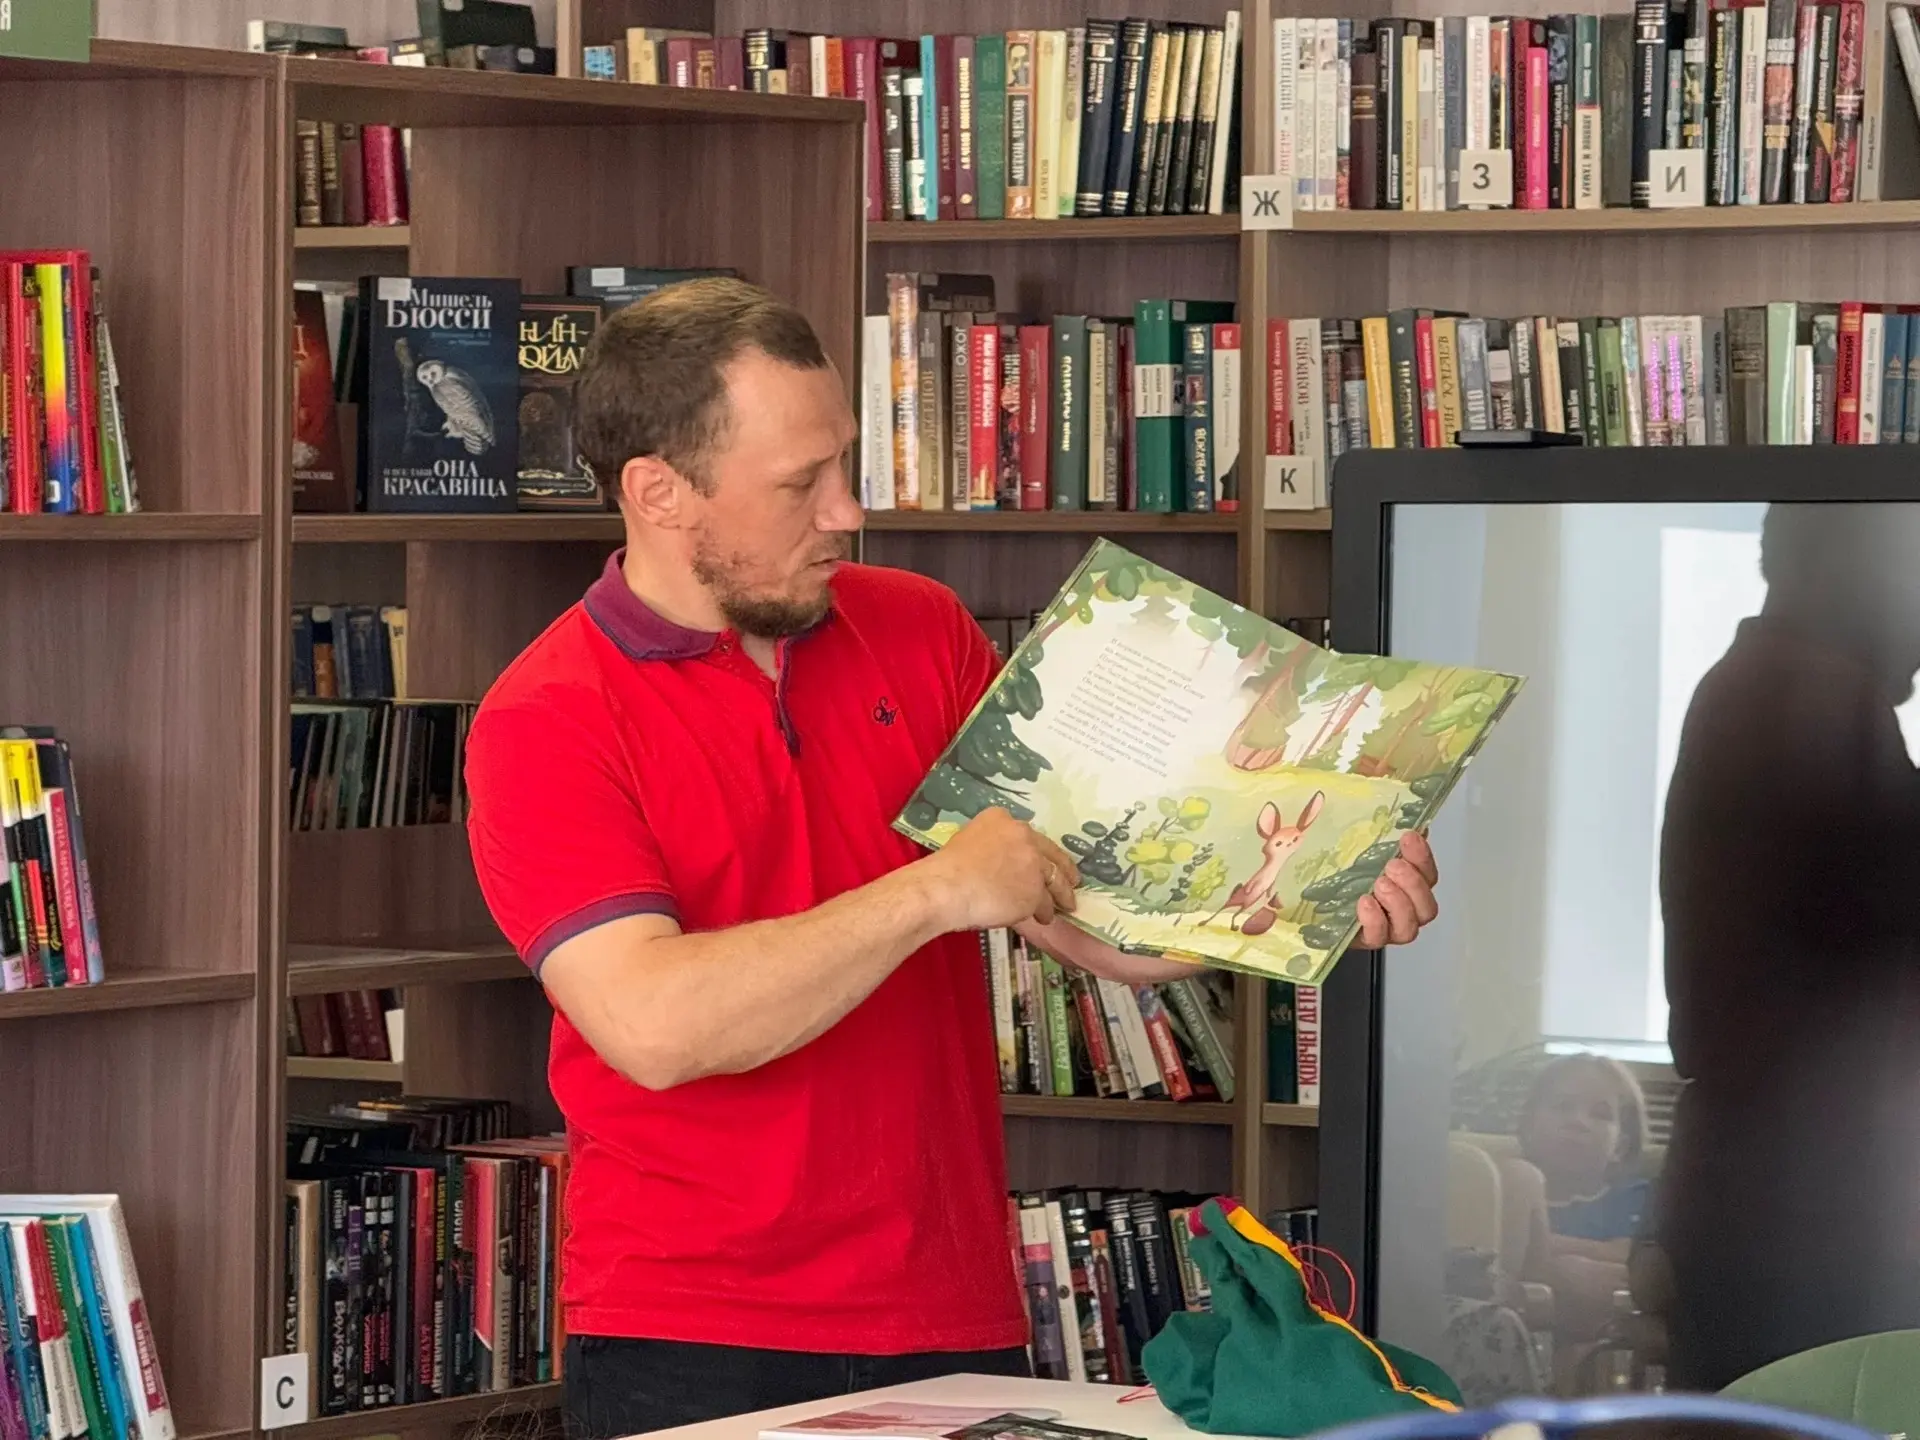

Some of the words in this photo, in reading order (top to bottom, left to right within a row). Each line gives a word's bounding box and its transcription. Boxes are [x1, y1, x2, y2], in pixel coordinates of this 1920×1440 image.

[1011, 99, 1025, 138] ЧЕХОВ
[1582, 115, 1592, 150] АПОЛЛОН
[1012, 143, 1026, 181] АНТОН
[1473, 163, 1490, 190] З
[1666, 166, 1686, 192] И
[1582, 164, 1592, 197] ТАМАРА
[1252, 190, 1280, 217] Ж
[385, 299, 492, 329] БЮССИ
[410, 288, 492, 308] Мишель
[955, 327, 967, 366] ОЖОГ
[1516, 322, 1530, 374] КАТАЕВ
[1438, 336, 1454, 398] КАТАЕВ
[1843, 335, 1854, 394] КОРЕЦКИЙ
[1273, 369, 1283, 412] КАБАКОВ
[1398, 359, 1414, 433] КАВЕРИН
[433, 460, 479, 477] ОНА
[1281, 468, 1297, 494] К
[384, 478, 508, 499] КРАСАВИЦА
[1297, 985, 1318, 1025] ДЕТЕ
[1297, 1030, 1318, 1086] КОВЧЕГ
[276, 1376, 295, 1409] С
